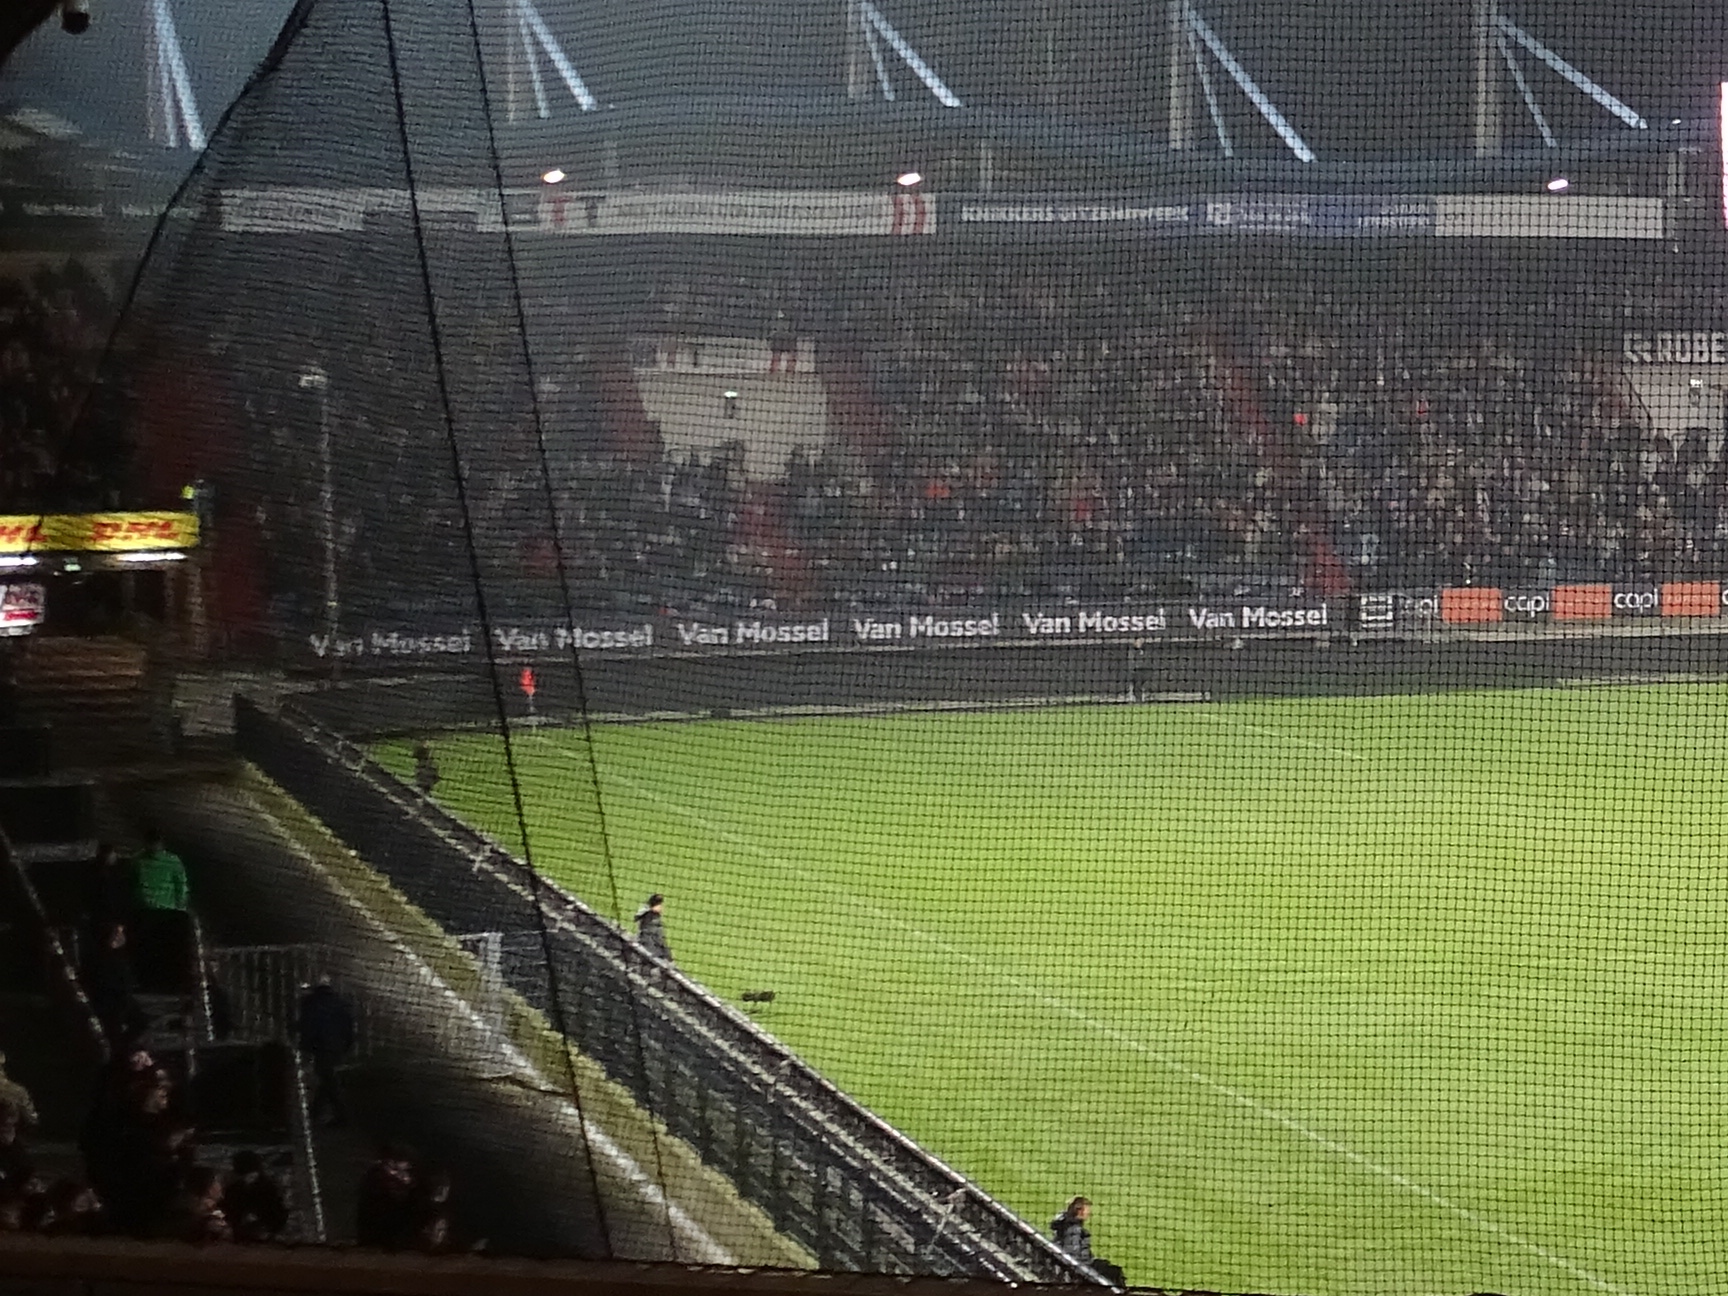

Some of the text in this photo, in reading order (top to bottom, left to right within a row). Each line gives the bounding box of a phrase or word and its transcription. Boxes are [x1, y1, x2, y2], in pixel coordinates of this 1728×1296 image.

[1504, 594, 1549, 618] capi
[1614, 588, 1659, 612] capi
[853, 612, 1000, 641] Van Mossel
[1022, 608, 1166, 634] Van Mossel
[1188, 603, 1328, 630] Van Mossel
[678, 617, 830, 645] Van Mossel
